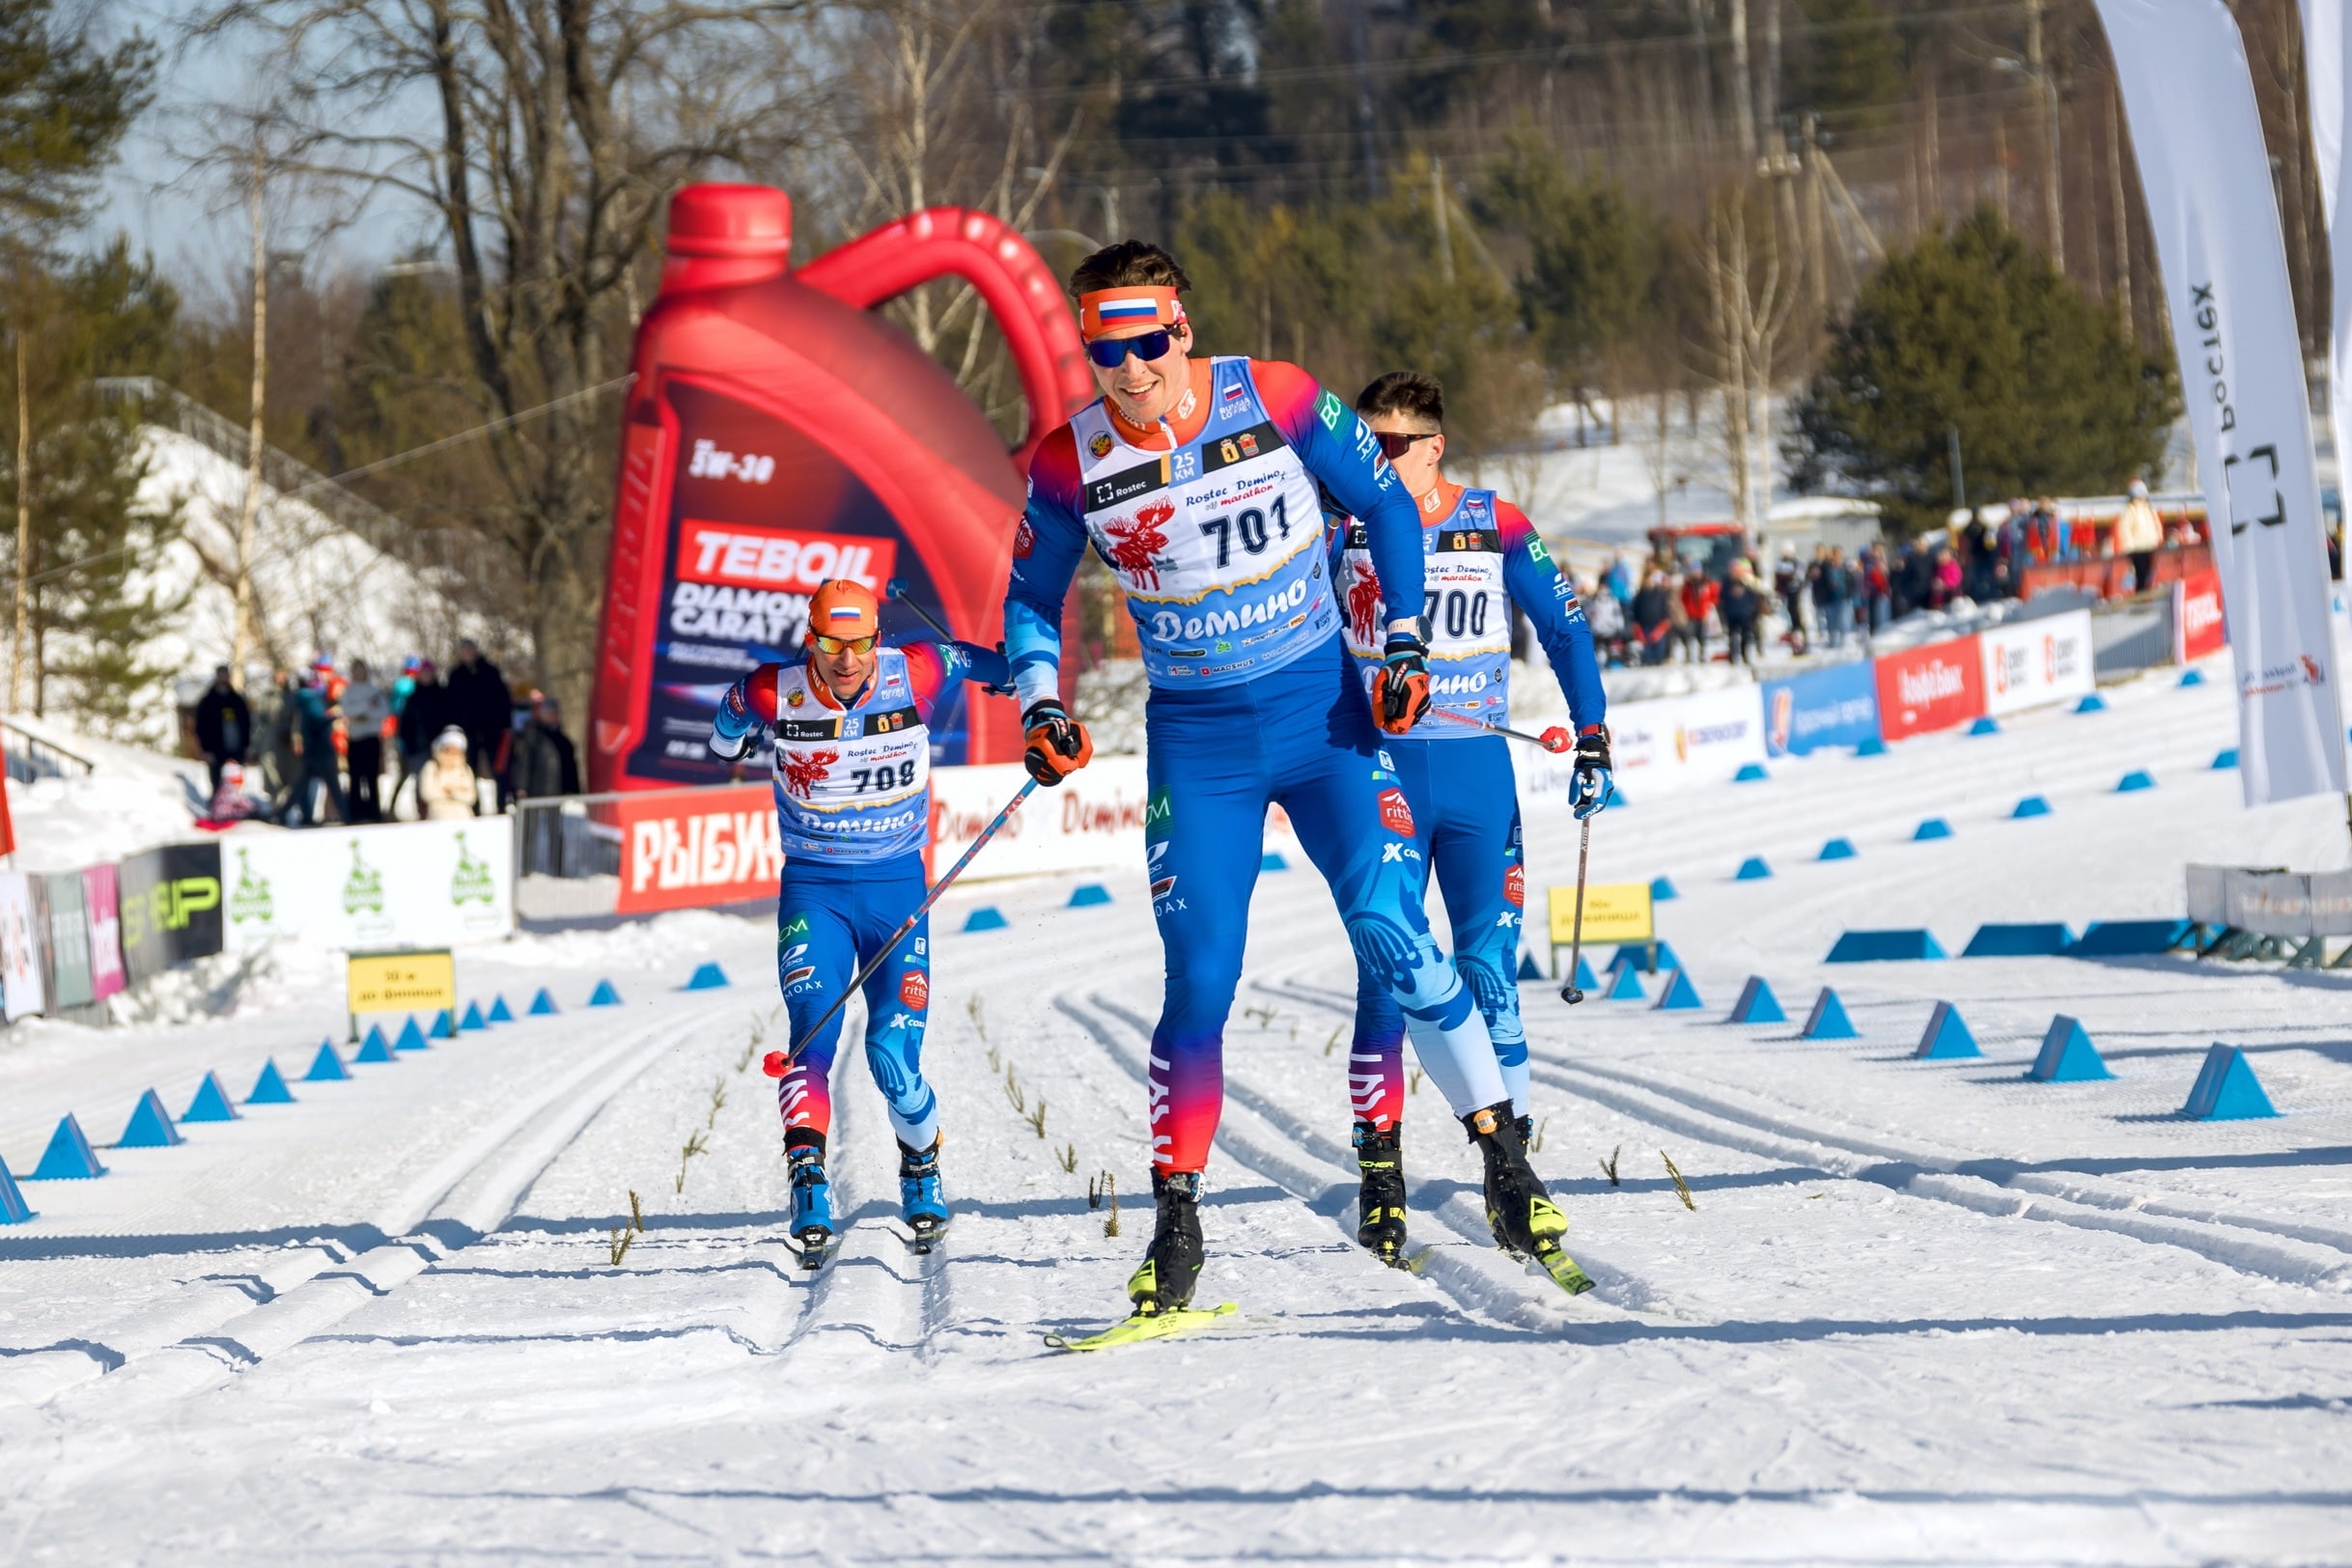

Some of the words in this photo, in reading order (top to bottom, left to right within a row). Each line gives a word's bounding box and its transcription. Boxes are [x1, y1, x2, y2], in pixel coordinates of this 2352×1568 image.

[1173, 451, 1195, 469] 25
[1174, 469, 1195, 482] KM
[1115, 481, 1147, 498] Rostec
[1186, 487, 1228, 507] Rostec
[1236, 469, 1281, 491] Demino
[1220, 484, 1274, 507] marathon
[1198, 492, 1291, 569] 701
[695, 530, 878, 590] TEBOIL
[1423, 565, 1449, 574] ostec
[1457, 565, 1490, 574] Demino
[672, 582, 811, 621] DIAMON
[1424, 589, 1488, 639] 700
[670, 606, 790, 645] CARAT
[1213, 659, 1253, 673] MADSHUS
[845, 718, 859, 729] 25
[843, 729, 857, 738] KM
[848, 748, 877, 757] Rostec
[882, 742, 913, 752] Demino
[870, 751, 908, 762] marathon
[850, 760, 915, 794] 708
[1155, 897, 1188, 918] OAX
[784, 981, 823, 1000] MOAX
